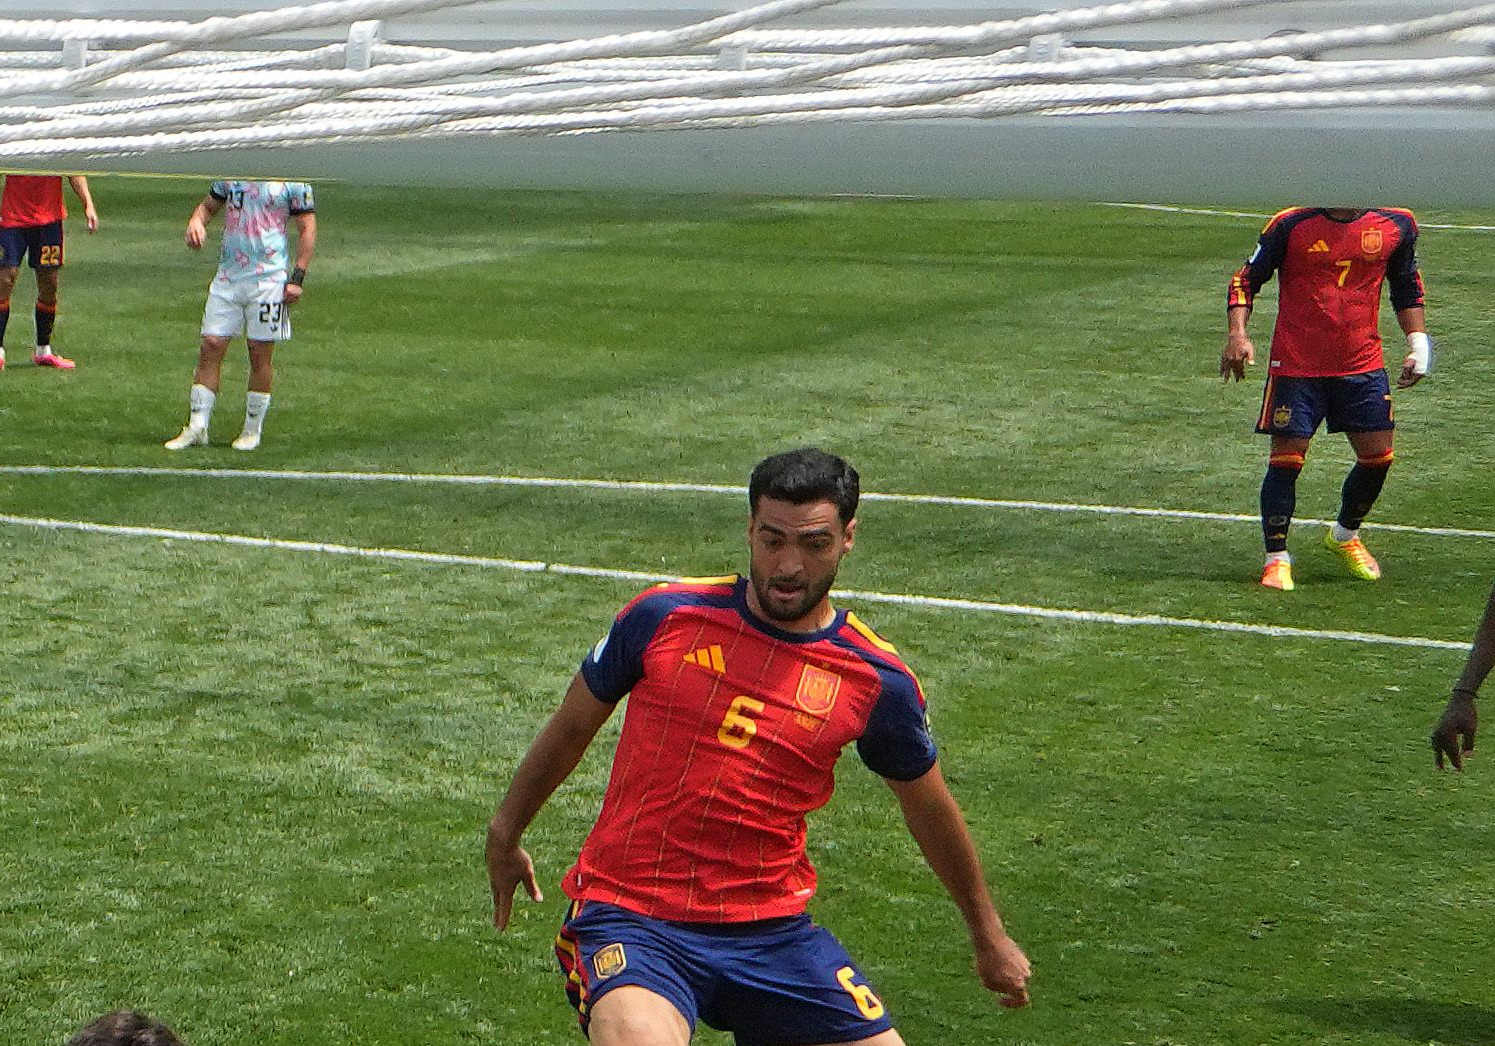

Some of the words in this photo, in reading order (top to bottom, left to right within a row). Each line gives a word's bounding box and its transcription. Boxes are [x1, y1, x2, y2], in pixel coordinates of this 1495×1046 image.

[40, 245, 60, 266] 22
[1335, 260, 1352, 288] 7
[259, 302, 281, 323] 23
[717, 695, 765, 748] 6
[836, 966, 884, 1020] 6
